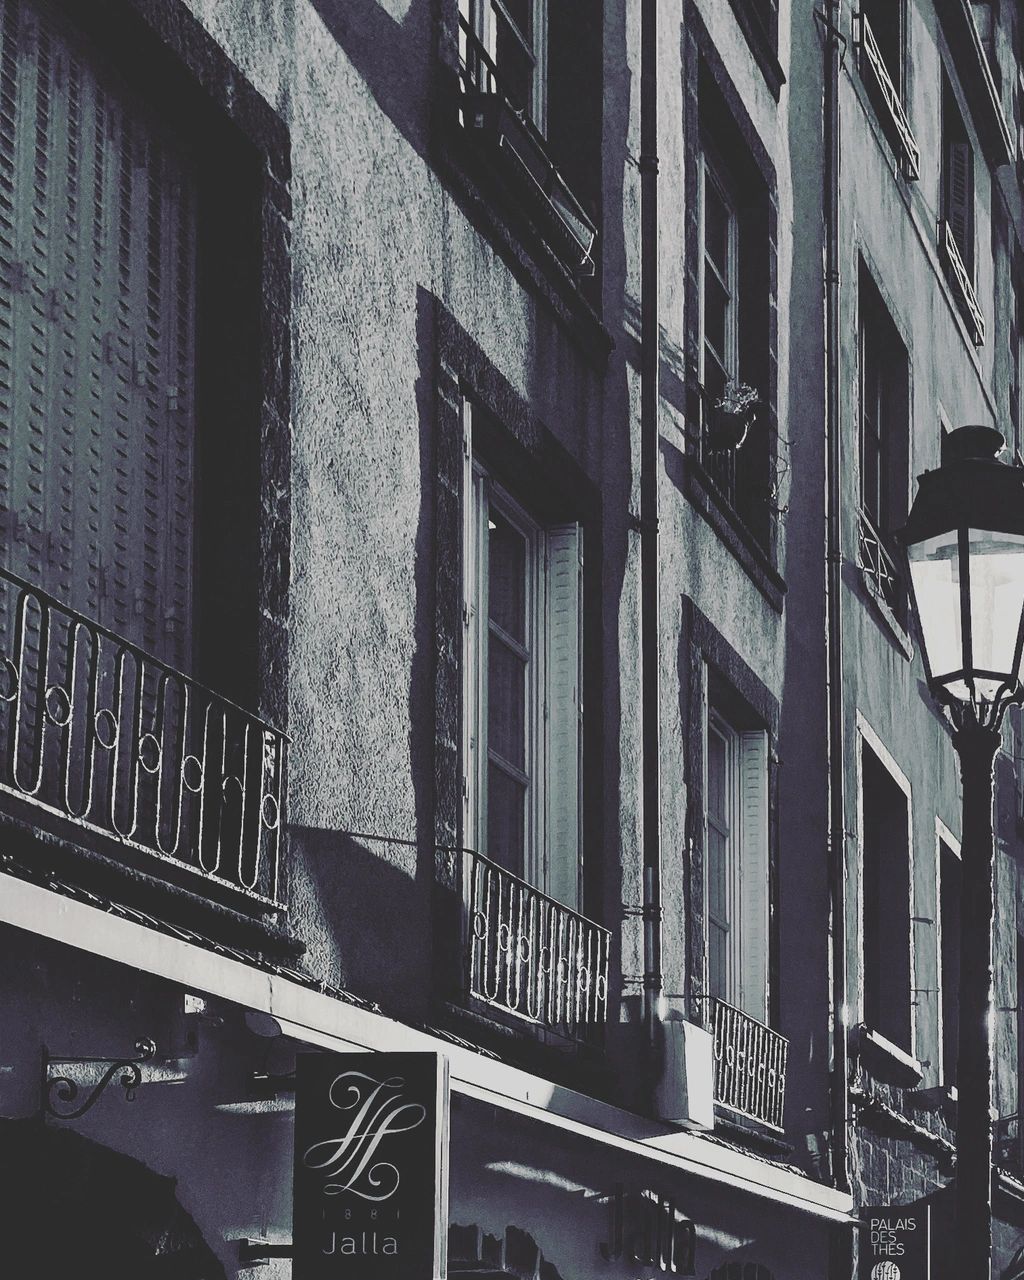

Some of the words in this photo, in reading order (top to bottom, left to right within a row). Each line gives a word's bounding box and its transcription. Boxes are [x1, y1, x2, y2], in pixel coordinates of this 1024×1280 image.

[322, 1208, 400, 1220] 1881
[870, 1218, 917, 1231] PALAIS
[323, 1231, 398, 1255] Jalla
[870, 1231, 897, 1243] DES
